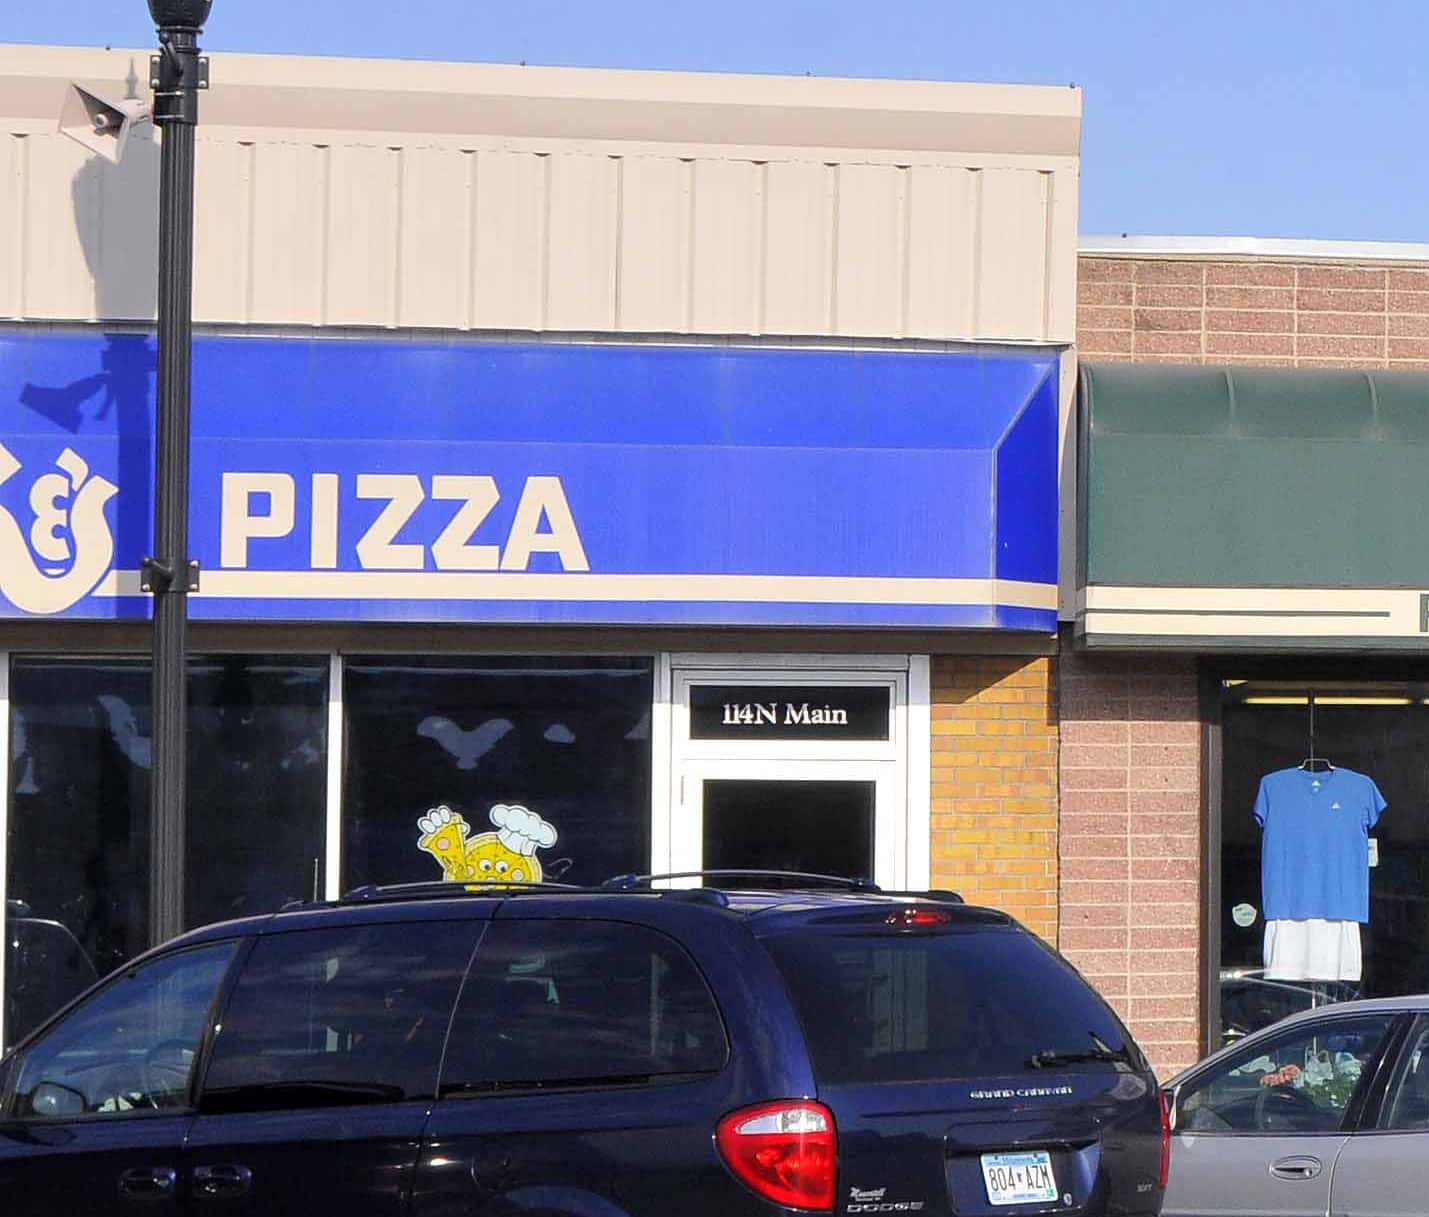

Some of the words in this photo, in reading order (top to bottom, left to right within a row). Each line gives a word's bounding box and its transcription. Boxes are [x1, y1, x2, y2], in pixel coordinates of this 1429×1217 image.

[220, 472, 591, 572] PIZZA
[783, 702, 848, 725] Main
[989, 1166, 1016, 1192] 804
